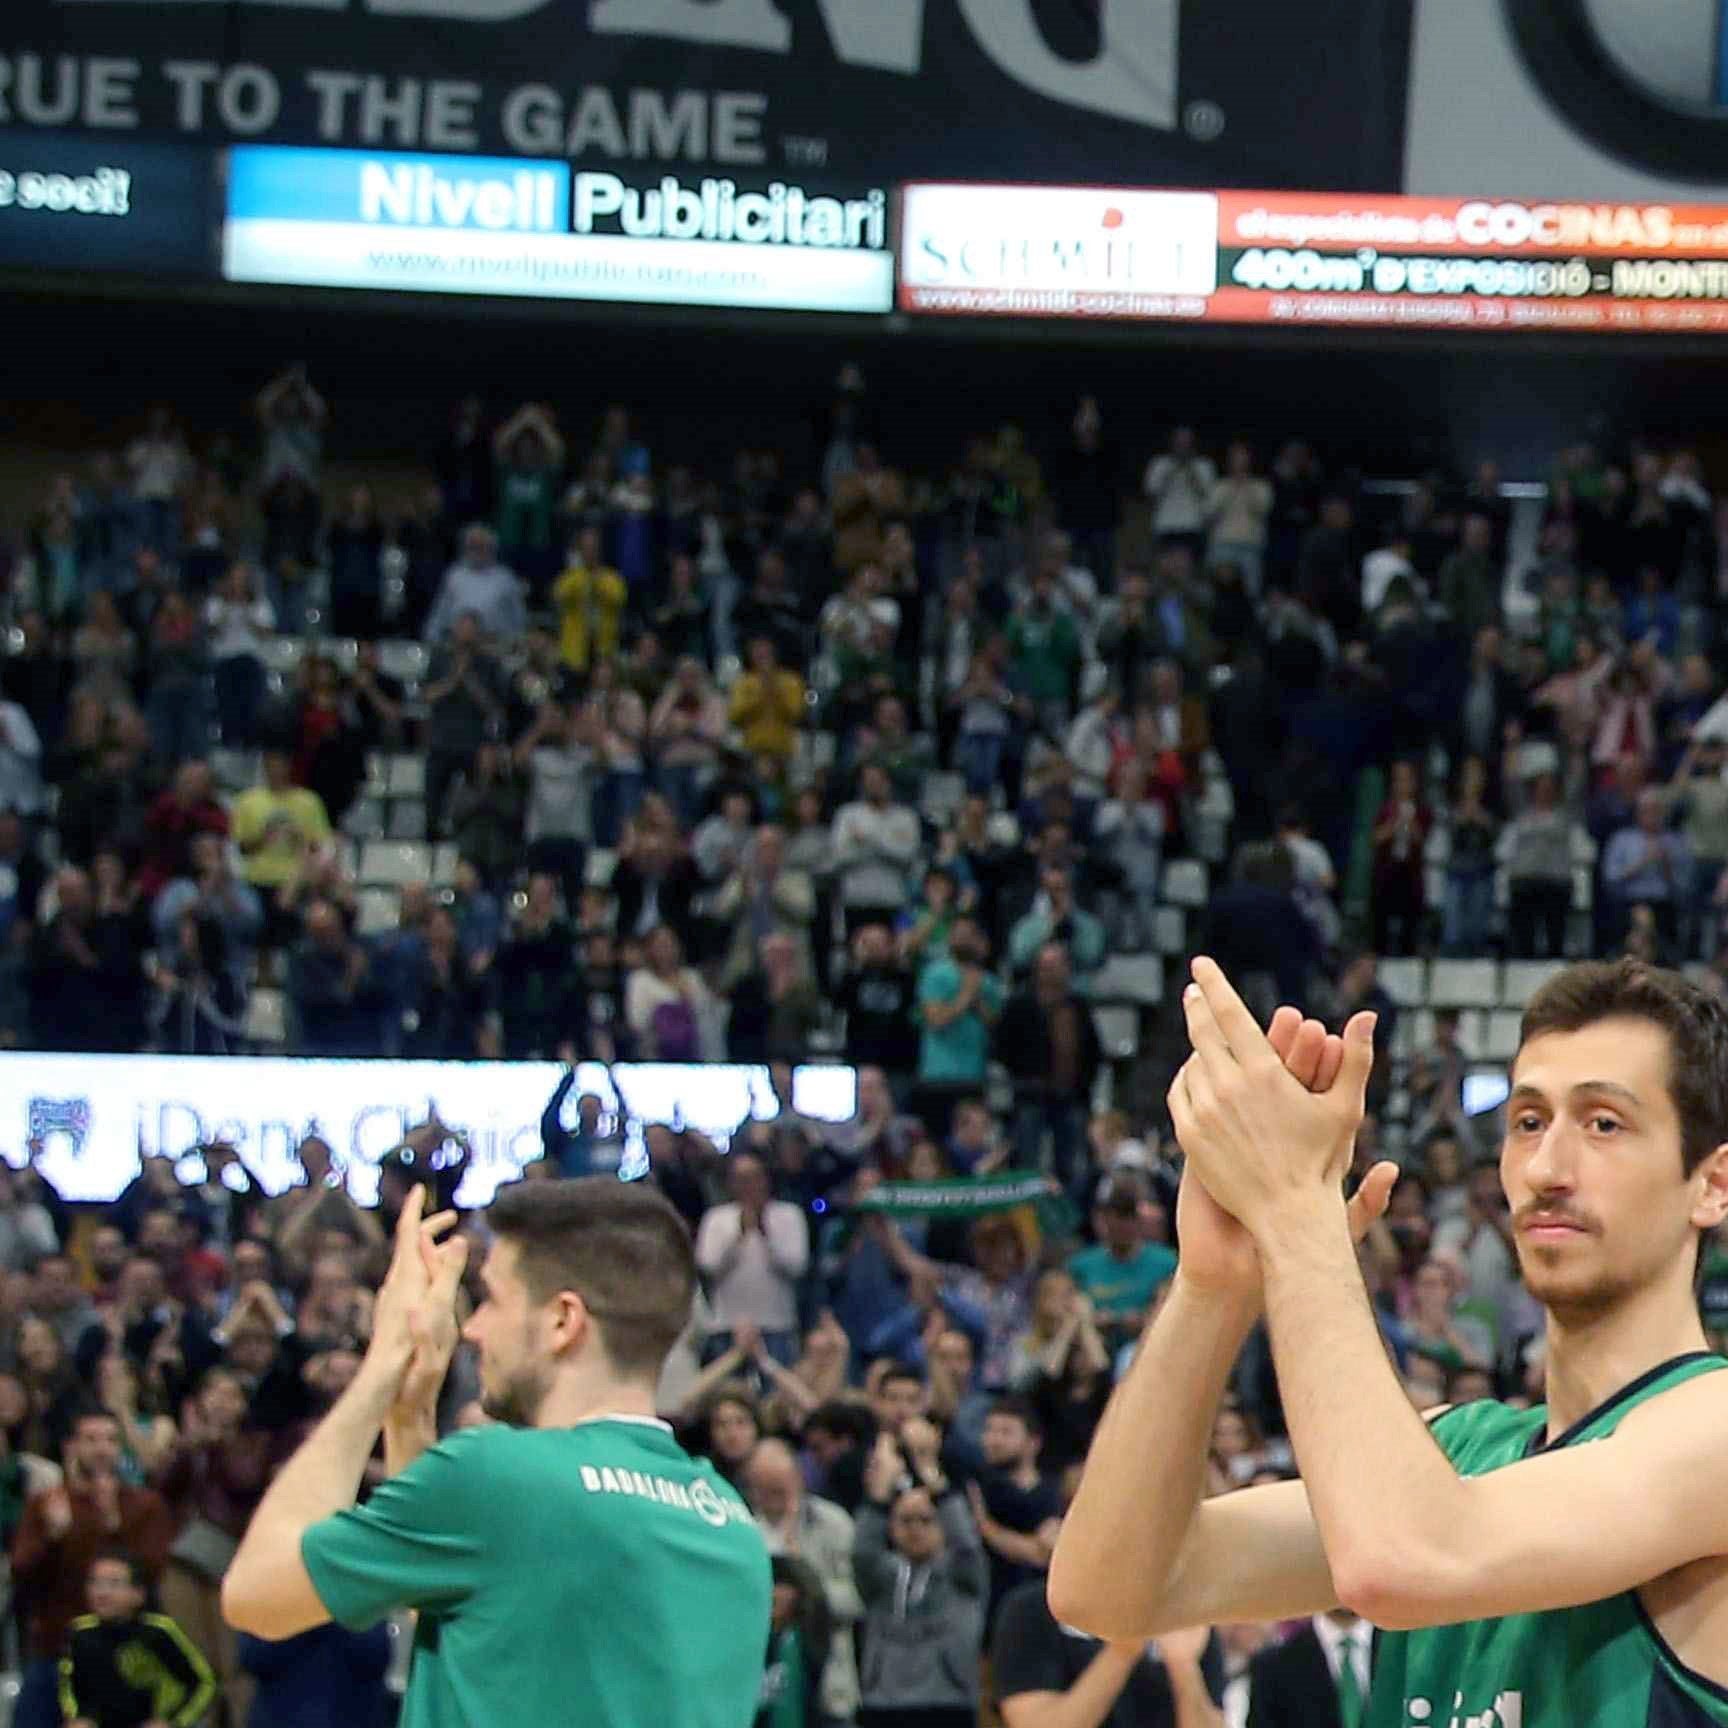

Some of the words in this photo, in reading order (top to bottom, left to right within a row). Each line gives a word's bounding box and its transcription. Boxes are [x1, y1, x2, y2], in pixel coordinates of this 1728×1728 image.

[162, 60, 280, 134] TO
[306, 70, 482, 149] THE
[504, 84, 768, 164] GAME
[358, 160, 556, 228] Nivell
[573, 172, 887, 249] Publicitari
[1456, 203, 1672, 248] COCINAS
